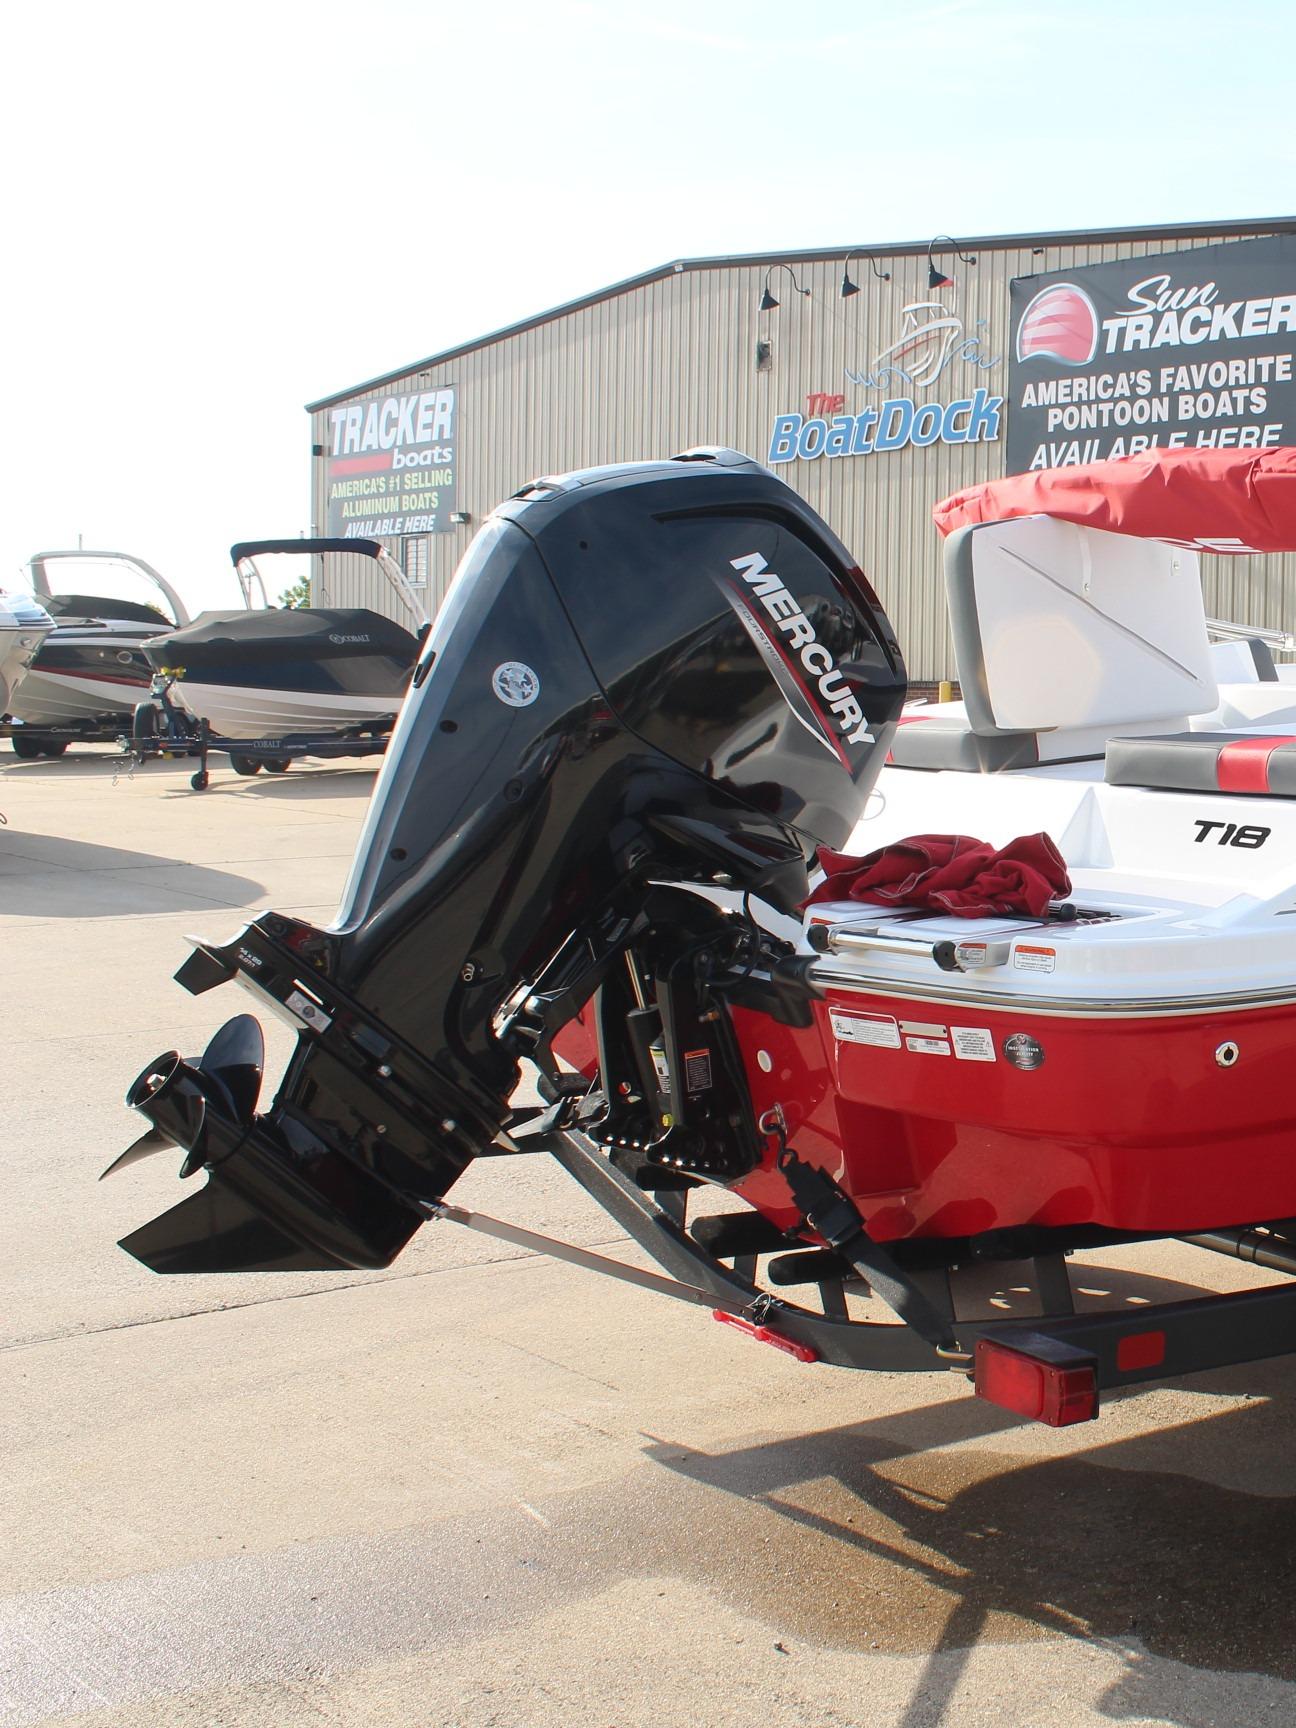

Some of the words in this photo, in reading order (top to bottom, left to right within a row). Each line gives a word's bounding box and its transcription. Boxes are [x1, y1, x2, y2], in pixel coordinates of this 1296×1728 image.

[1114, 274, 1219, 316] Sun
[1021, 369, 1152, 408] AMERICA'S
[1160, 354, 1293, 393] FAVORITE
[806, 392, 846, 416] The
[1047, 396, 1170, 433] PONTOON
[1178, 387, 1268, 421] BOATS
[331, 389, 454, 456] TRACKER
[392, 445, 453, 469] boats
[331, 476, 386, 499] AMERICA'S
[404, 469, 453, 490] SELLING
[342, 495, 399, 518] ALUMINUM
[402, 492, 439, 511] BOATS
[344, 516, 402, 539] AVAILABLE
[404, 515, 435, 532] HERE
[729, 551, 876, 745] MERCURY
[1193, 819, 1272, 849] T18
